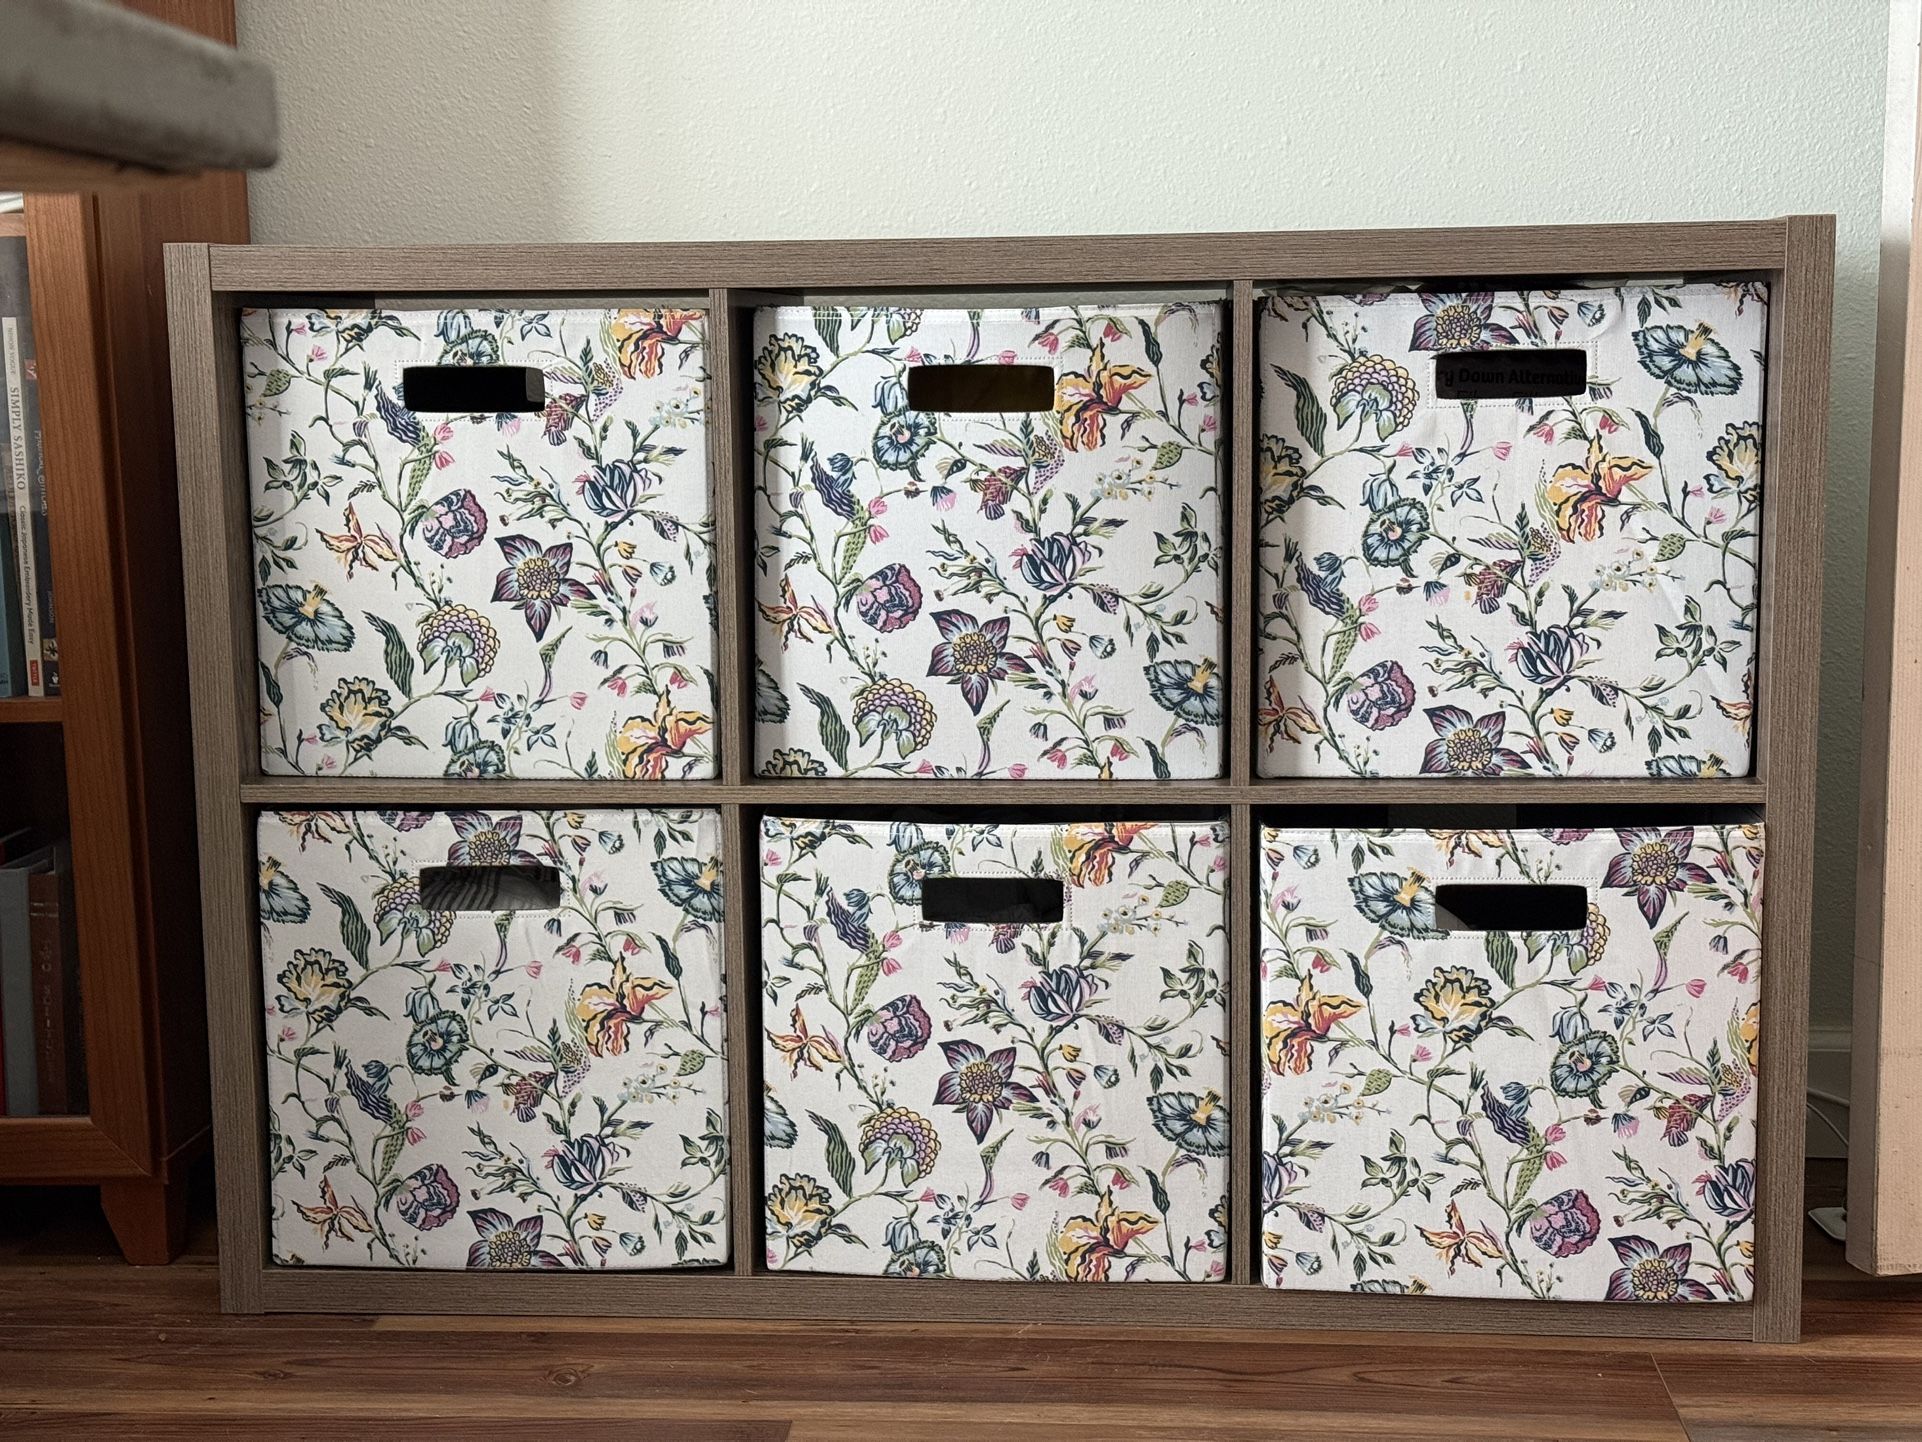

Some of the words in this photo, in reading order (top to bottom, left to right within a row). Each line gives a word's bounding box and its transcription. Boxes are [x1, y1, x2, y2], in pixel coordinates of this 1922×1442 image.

[1459, 367, 1504, 384] Down
[10, 387, 23, 432] SIMPLY
[13, 436, 26, 490] SASHIKO
[19, 505, 27, 530] Classic
[20, 532, 30, 564] Japanese
[23, 566, 35, 606] Embroidery
[28, 628, 36, 645] Easy
